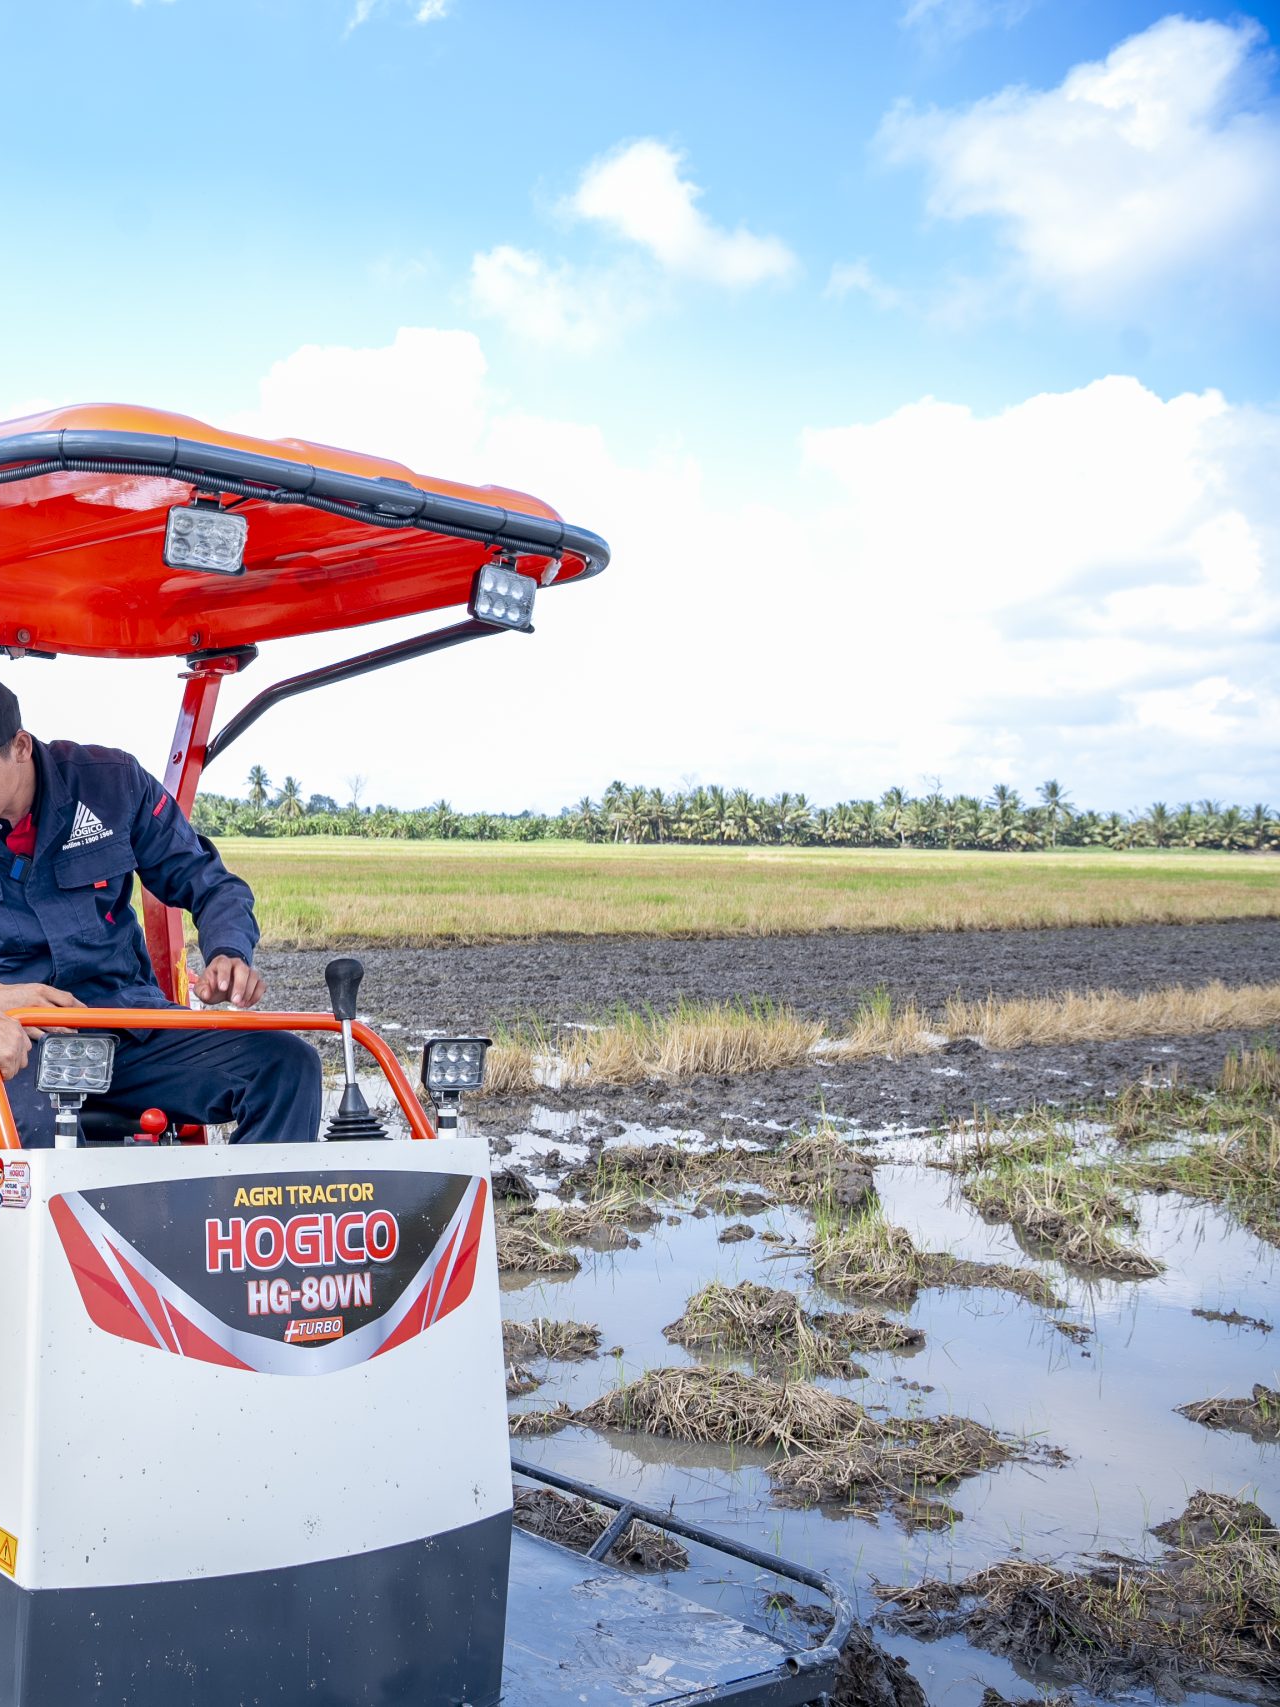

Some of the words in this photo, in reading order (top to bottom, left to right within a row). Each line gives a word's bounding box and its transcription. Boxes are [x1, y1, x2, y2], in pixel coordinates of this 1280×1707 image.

[233, 1186, 283, 1207] AGRI
[285, 1183, 374, 1205] TRACTOR
[205, 1209, 399, 1273] HOGICO
[247, 1271, 373, 1316] HG-80VN
